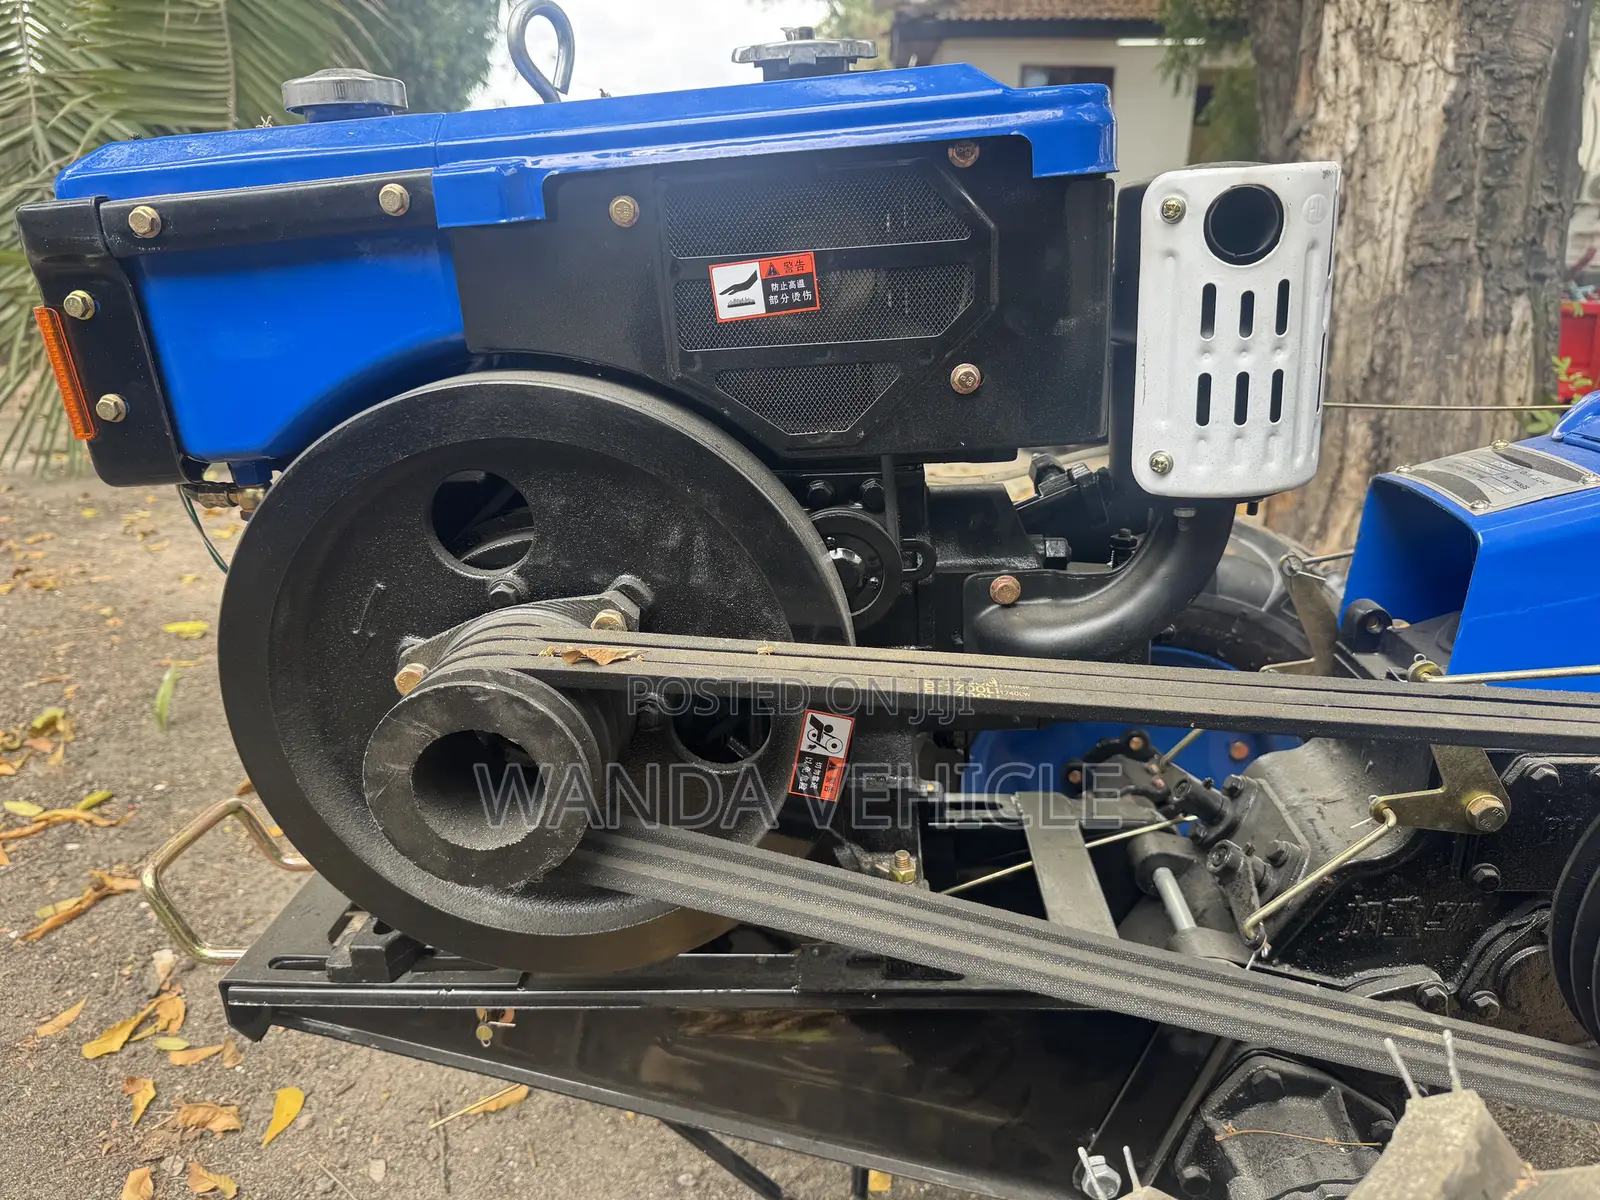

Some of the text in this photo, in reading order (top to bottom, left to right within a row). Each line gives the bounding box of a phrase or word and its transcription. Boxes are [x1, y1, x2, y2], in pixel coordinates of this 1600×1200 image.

[783, 259, 805, 273] 警告
[770, 278, 806, 292] 防止高温
[768, 290, 813, 305] 部分烫伤
